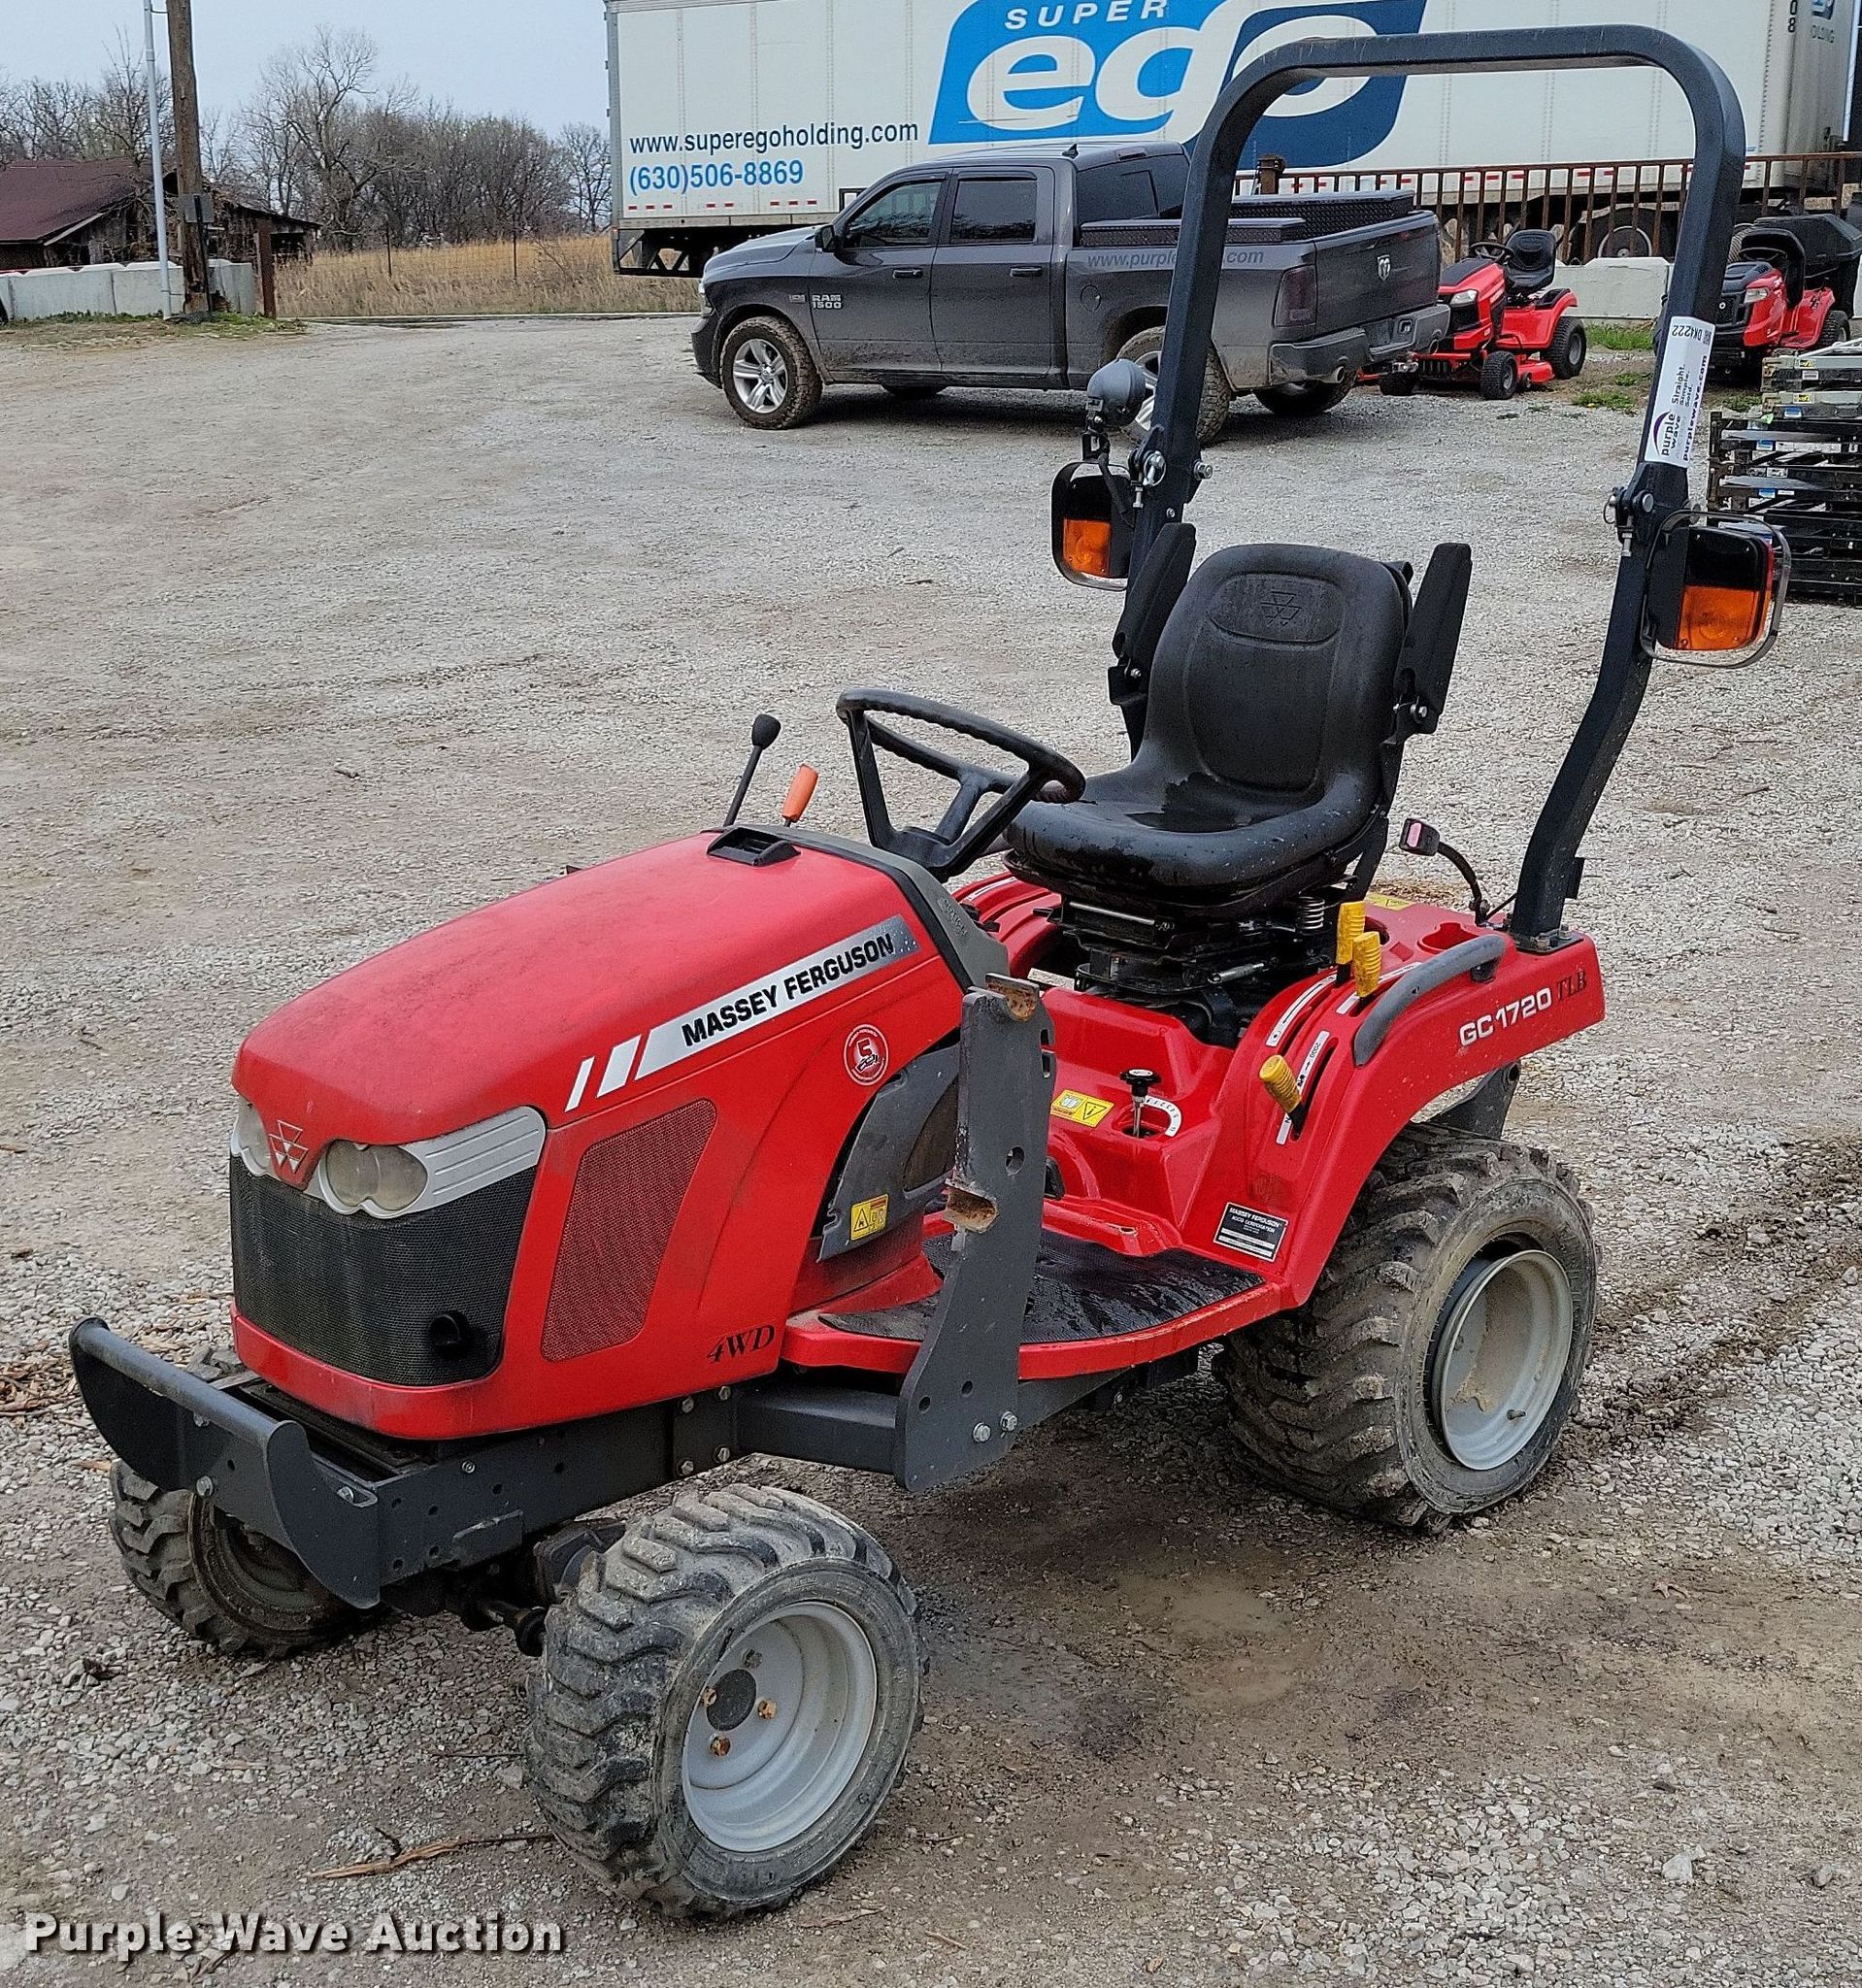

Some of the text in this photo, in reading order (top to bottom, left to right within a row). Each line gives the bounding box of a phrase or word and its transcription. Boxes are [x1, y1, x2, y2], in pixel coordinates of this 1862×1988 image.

[1004, 0, 1167, 30] SUPER
[630, 122, 918, 155] www.superegoholding.com
[629, 159, 804, 195] (630)506-8869
[1682, 355, 1707, 461] purplewave.com
[1661, 414, 1676, 456] purple
[1671, 415, 1680, 449] wave
[682, 933, 894, 1046] MASSEY FERGUSON
[1556, 970, 1587, 1001] TLB
[707, 1324, 775, 1363] 4WD
